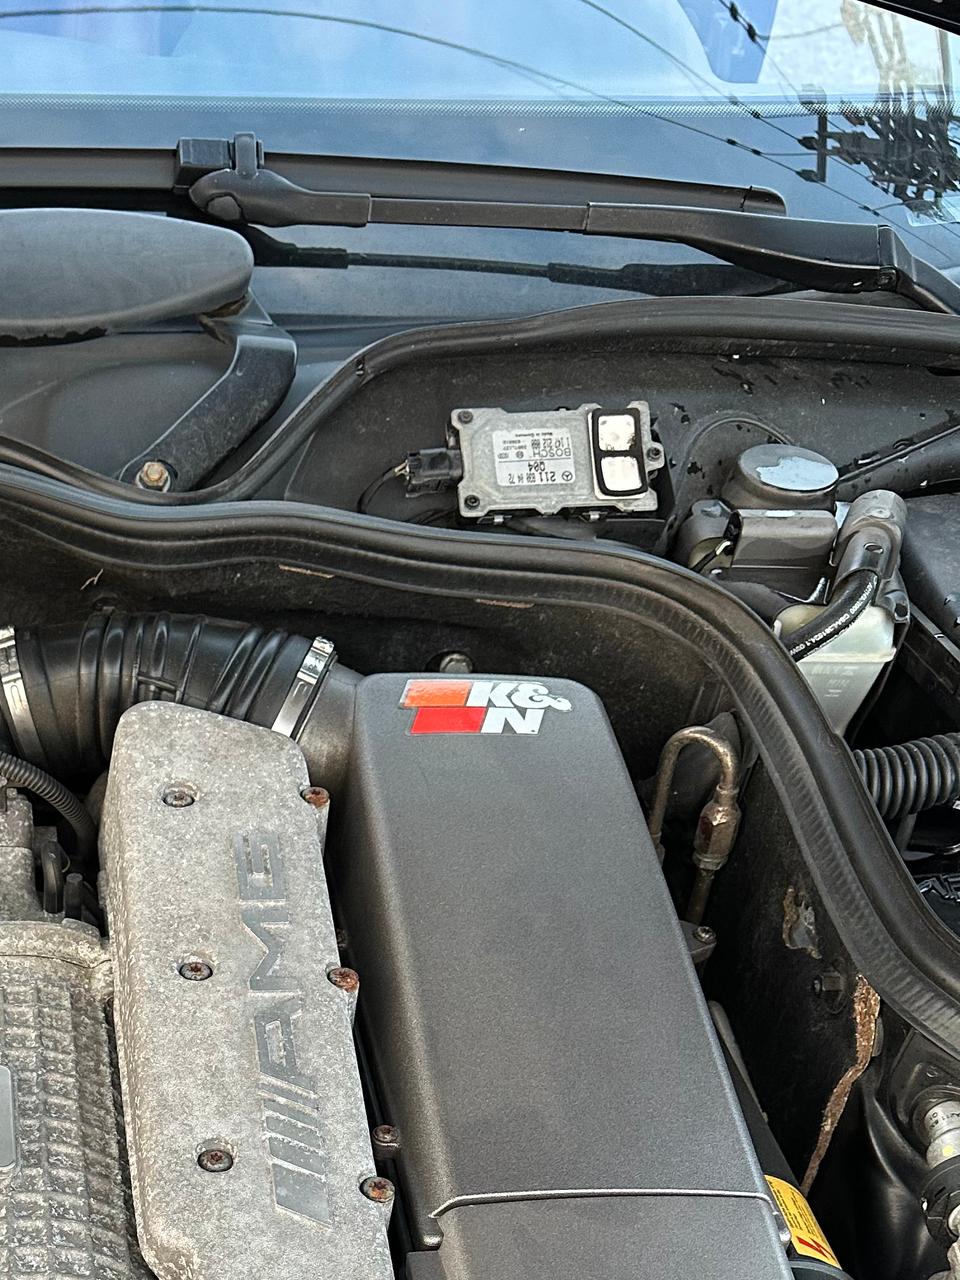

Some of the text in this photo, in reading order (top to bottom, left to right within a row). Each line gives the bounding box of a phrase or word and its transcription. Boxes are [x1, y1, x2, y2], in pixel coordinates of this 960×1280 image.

[533, 448, 572, 458] BOSCH
[538, 471, 557, 482] 211
[236, 832, 322, 1098] AMG
